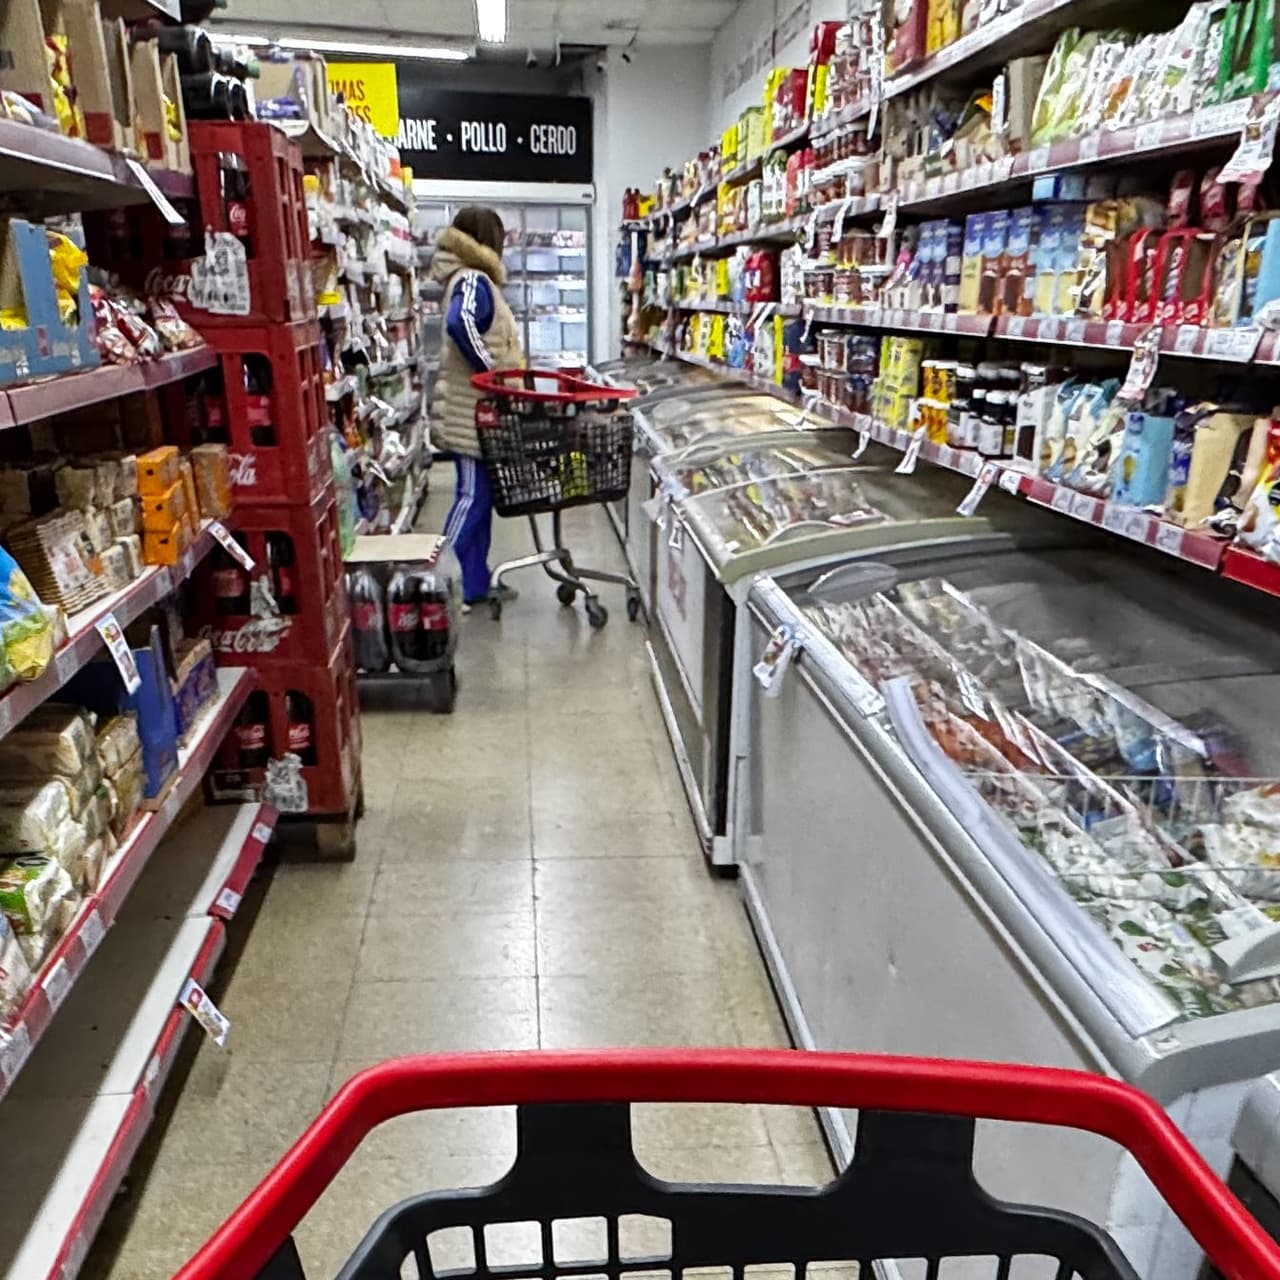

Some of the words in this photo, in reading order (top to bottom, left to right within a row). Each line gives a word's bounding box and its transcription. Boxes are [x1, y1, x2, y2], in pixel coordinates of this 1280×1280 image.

[397, 118, 437, 150] ARNE
[461, 121, 506, 152] POLLO
[530, 124, 576, 155] CERDO
